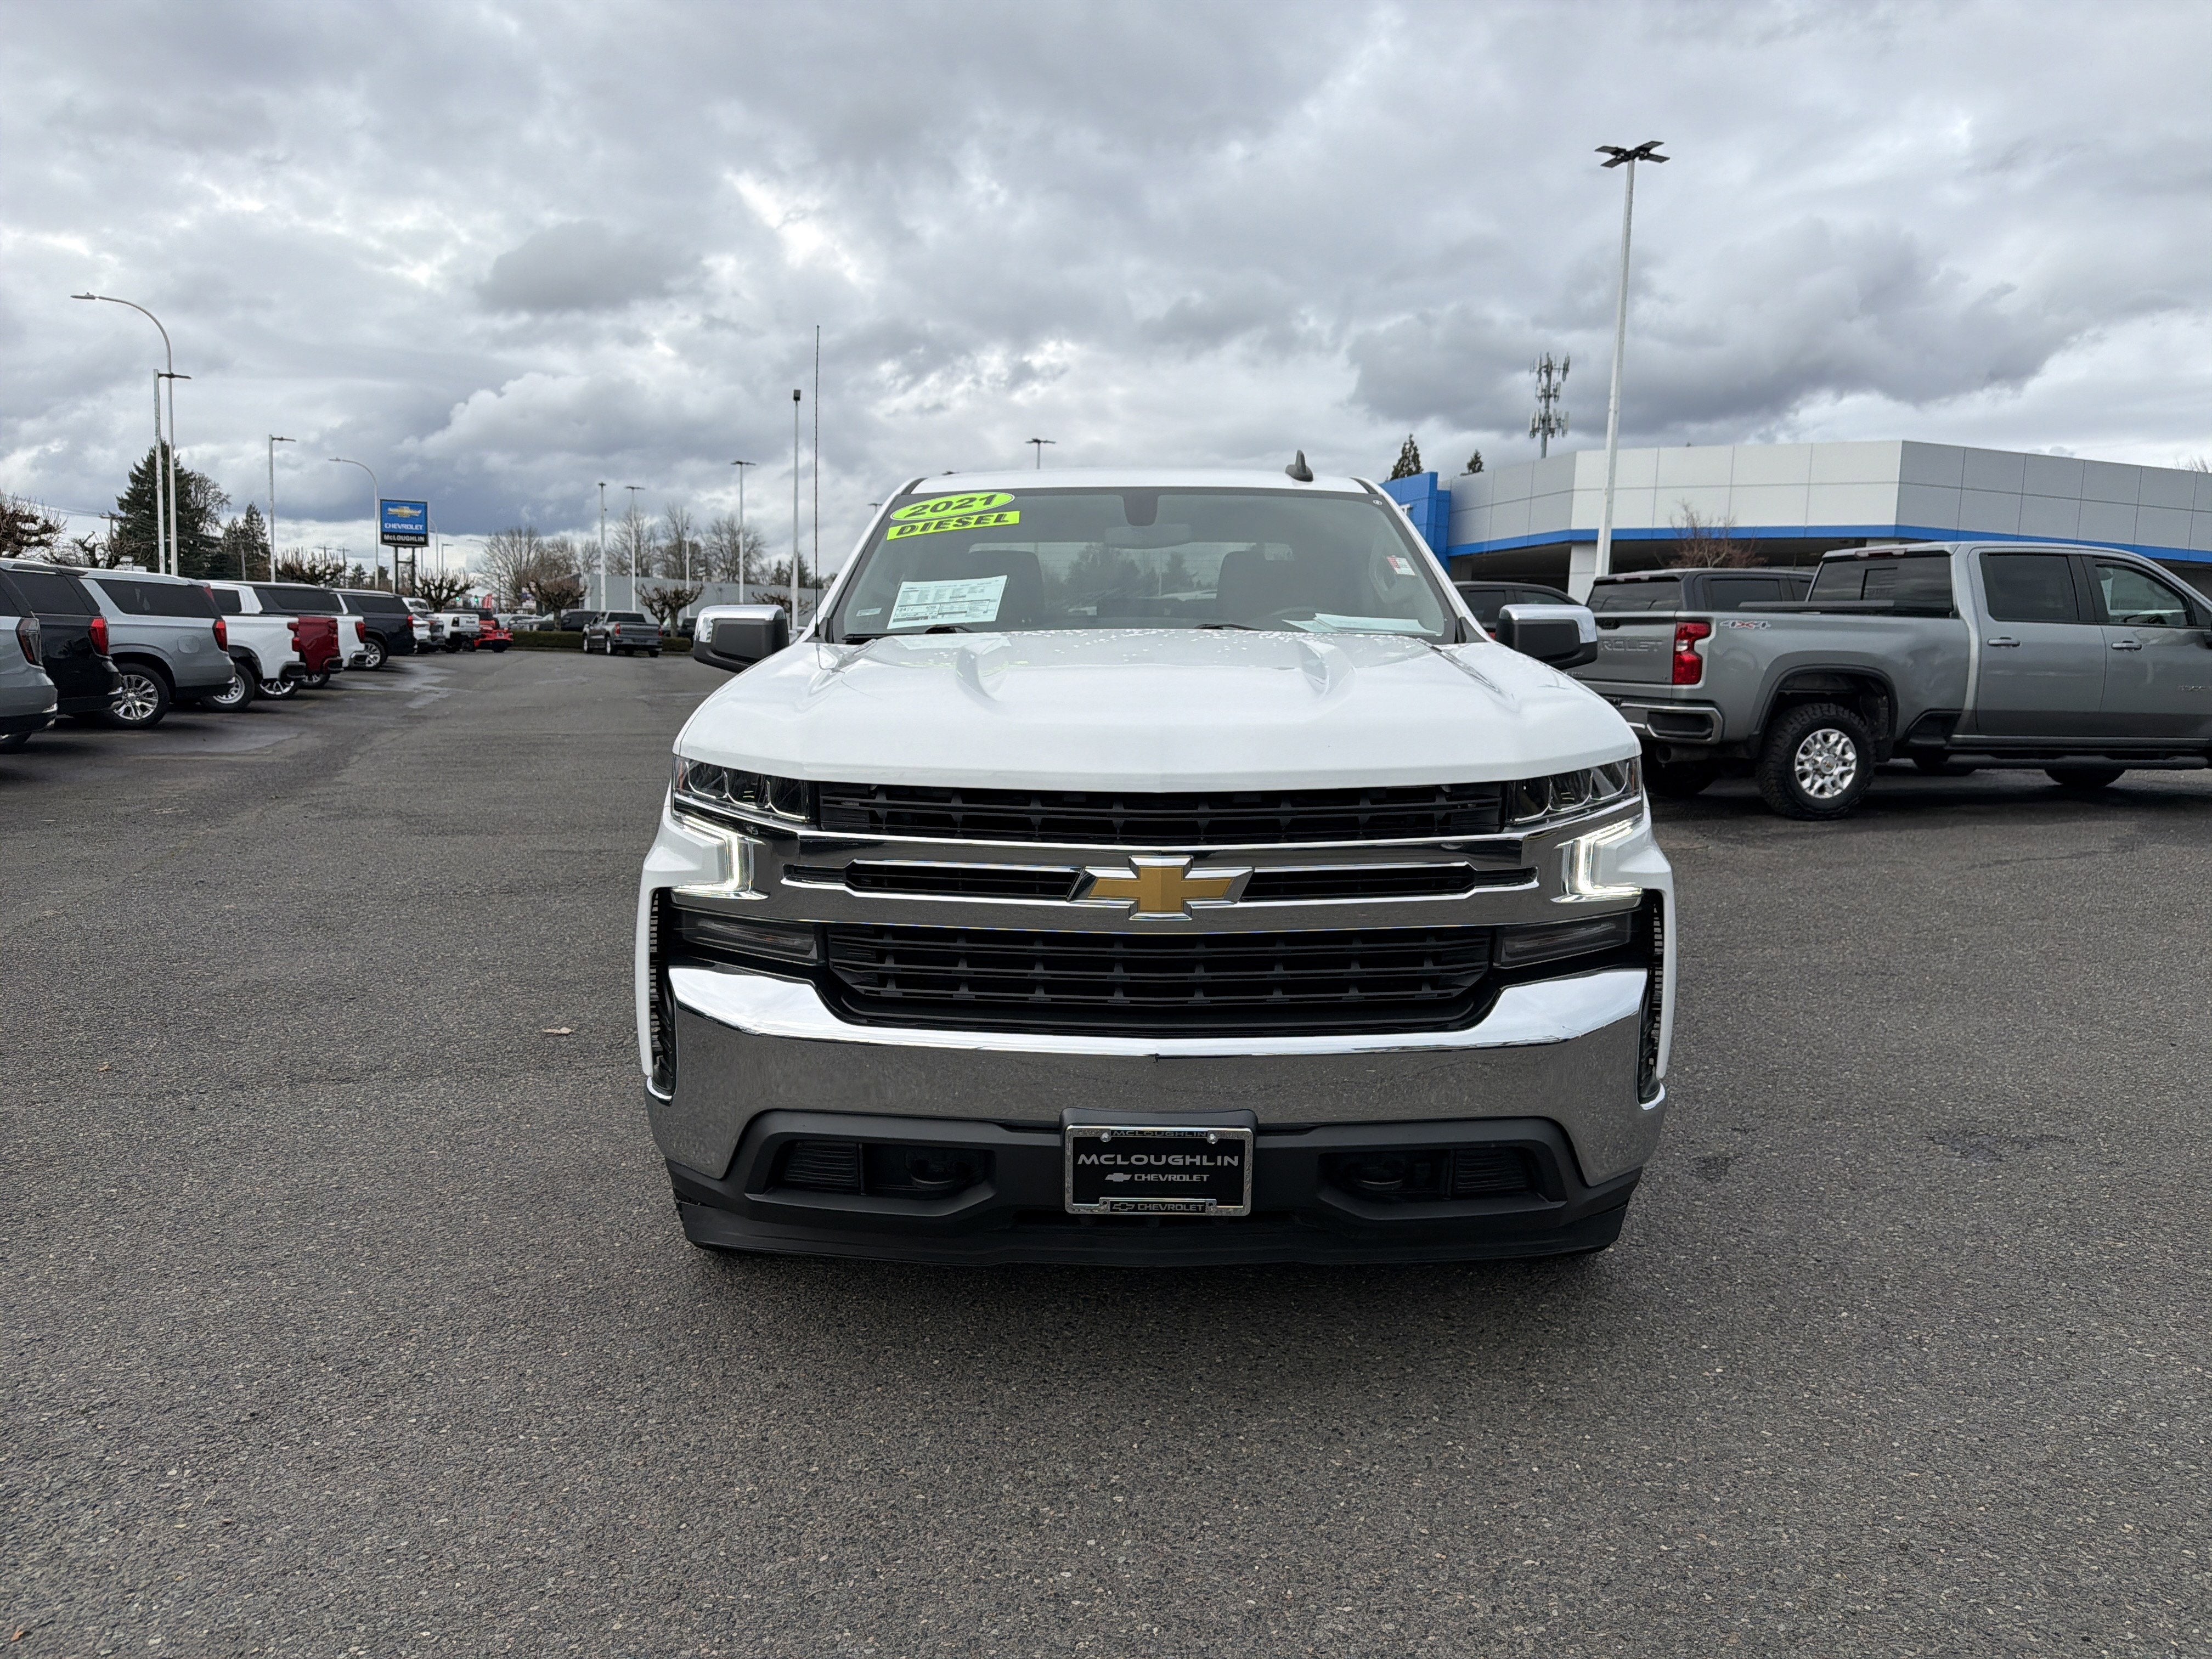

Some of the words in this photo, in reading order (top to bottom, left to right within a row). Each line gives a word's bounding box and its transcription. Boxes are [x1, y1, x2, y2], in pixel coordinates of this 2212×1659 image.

[904, 494, 997, 518] 2021
[896, 514, 1008, 536] DIESEL
[1077, 1154, 1239, 1166] MCLOUGHLIN
[1134, 1173, 1210, 1182] CHEVROLET
[1137, 1203, 1204, 1211] CHEVROLET
